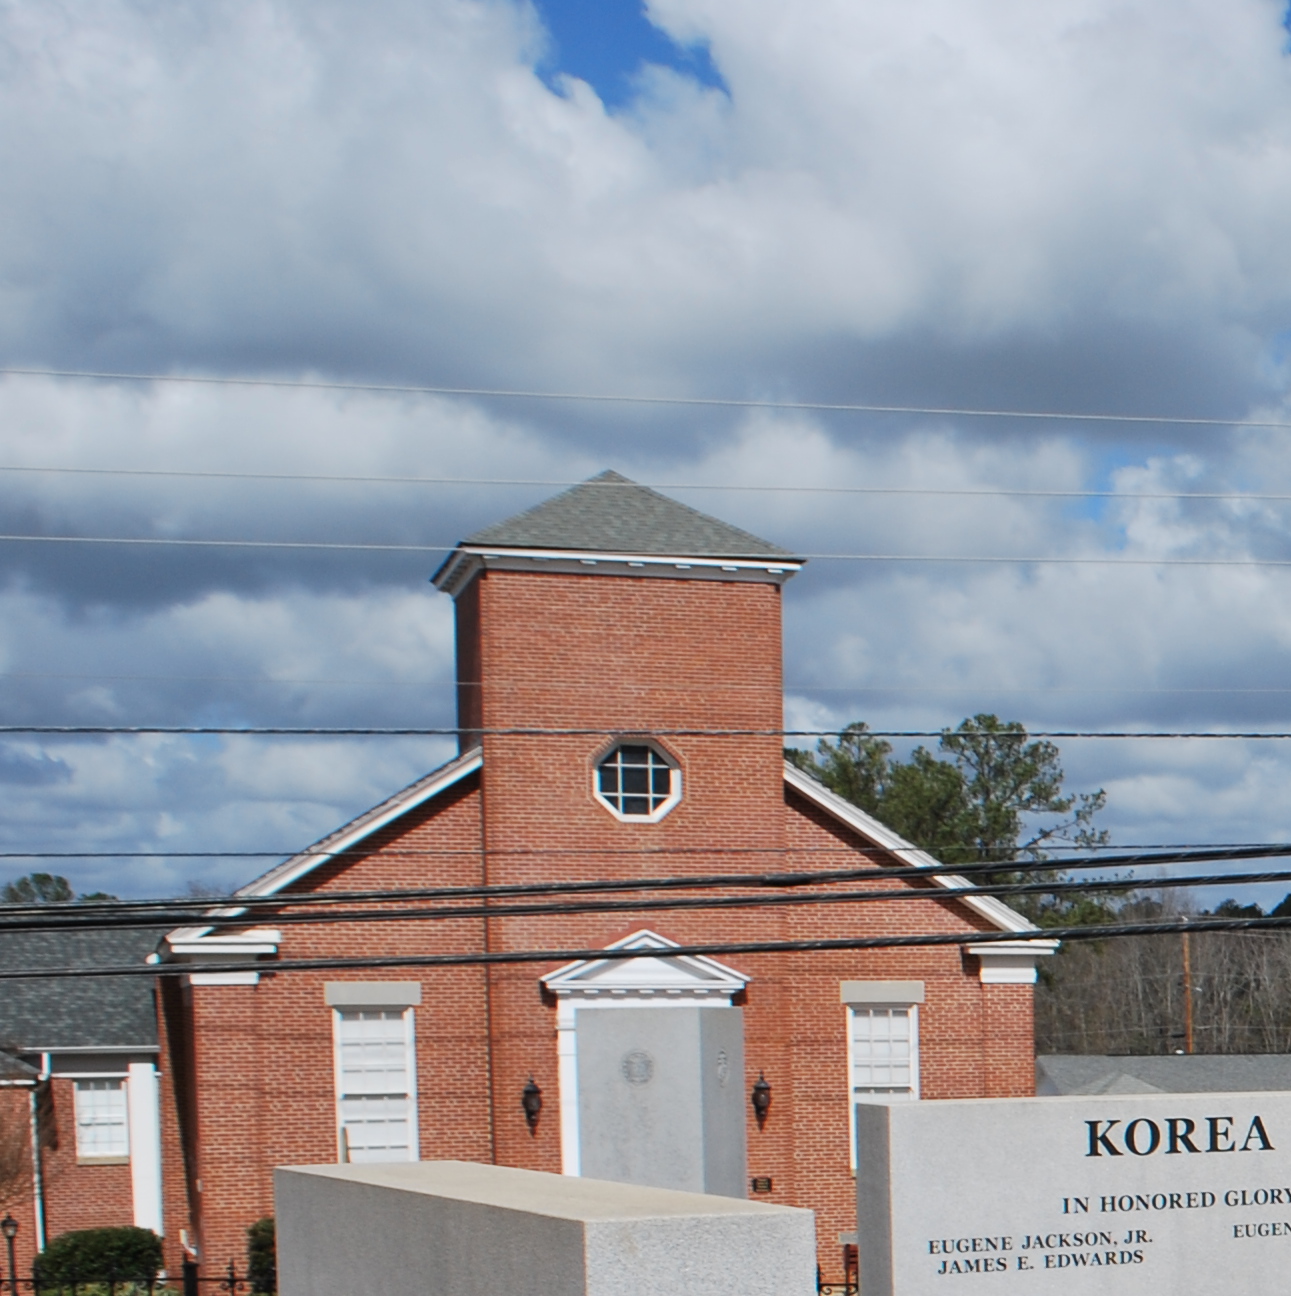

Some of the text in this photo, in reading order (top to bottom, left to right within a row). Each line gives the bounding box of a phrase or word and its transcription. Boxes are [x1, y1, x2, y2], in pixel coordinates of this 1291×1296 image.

[1084, 1115, 1275, 1157] KOREA
[1063, 1197, 1089, 1214] IN
[1100, 1192, 1216, 1212] HONORED
[929, 1230, 1153, 1254] EUGENE JACKSON, JR.
[937, 1250, 1144, 1275] JAMES E. EDWARDS
